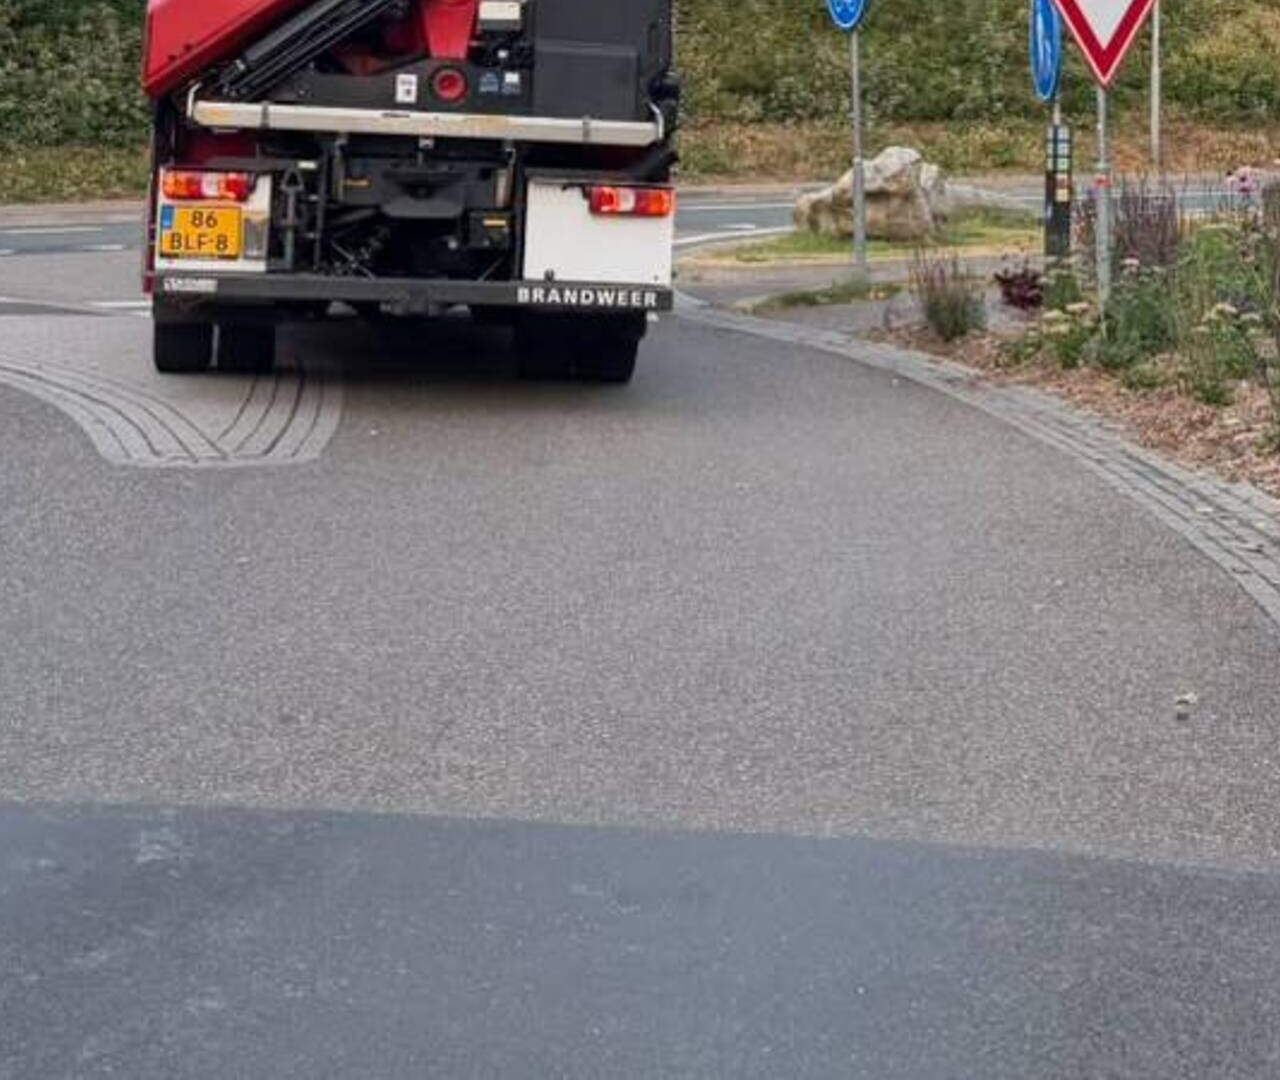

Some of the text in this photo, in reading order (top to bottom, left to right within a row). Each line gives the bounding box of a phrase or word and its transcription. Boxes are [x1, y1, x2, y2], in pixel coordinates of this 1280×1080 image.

[191, 210, 218, 228] 86
[170, 232, 229, 252] BLF-8
[516, 286, 657, 307] BRANDWEER
